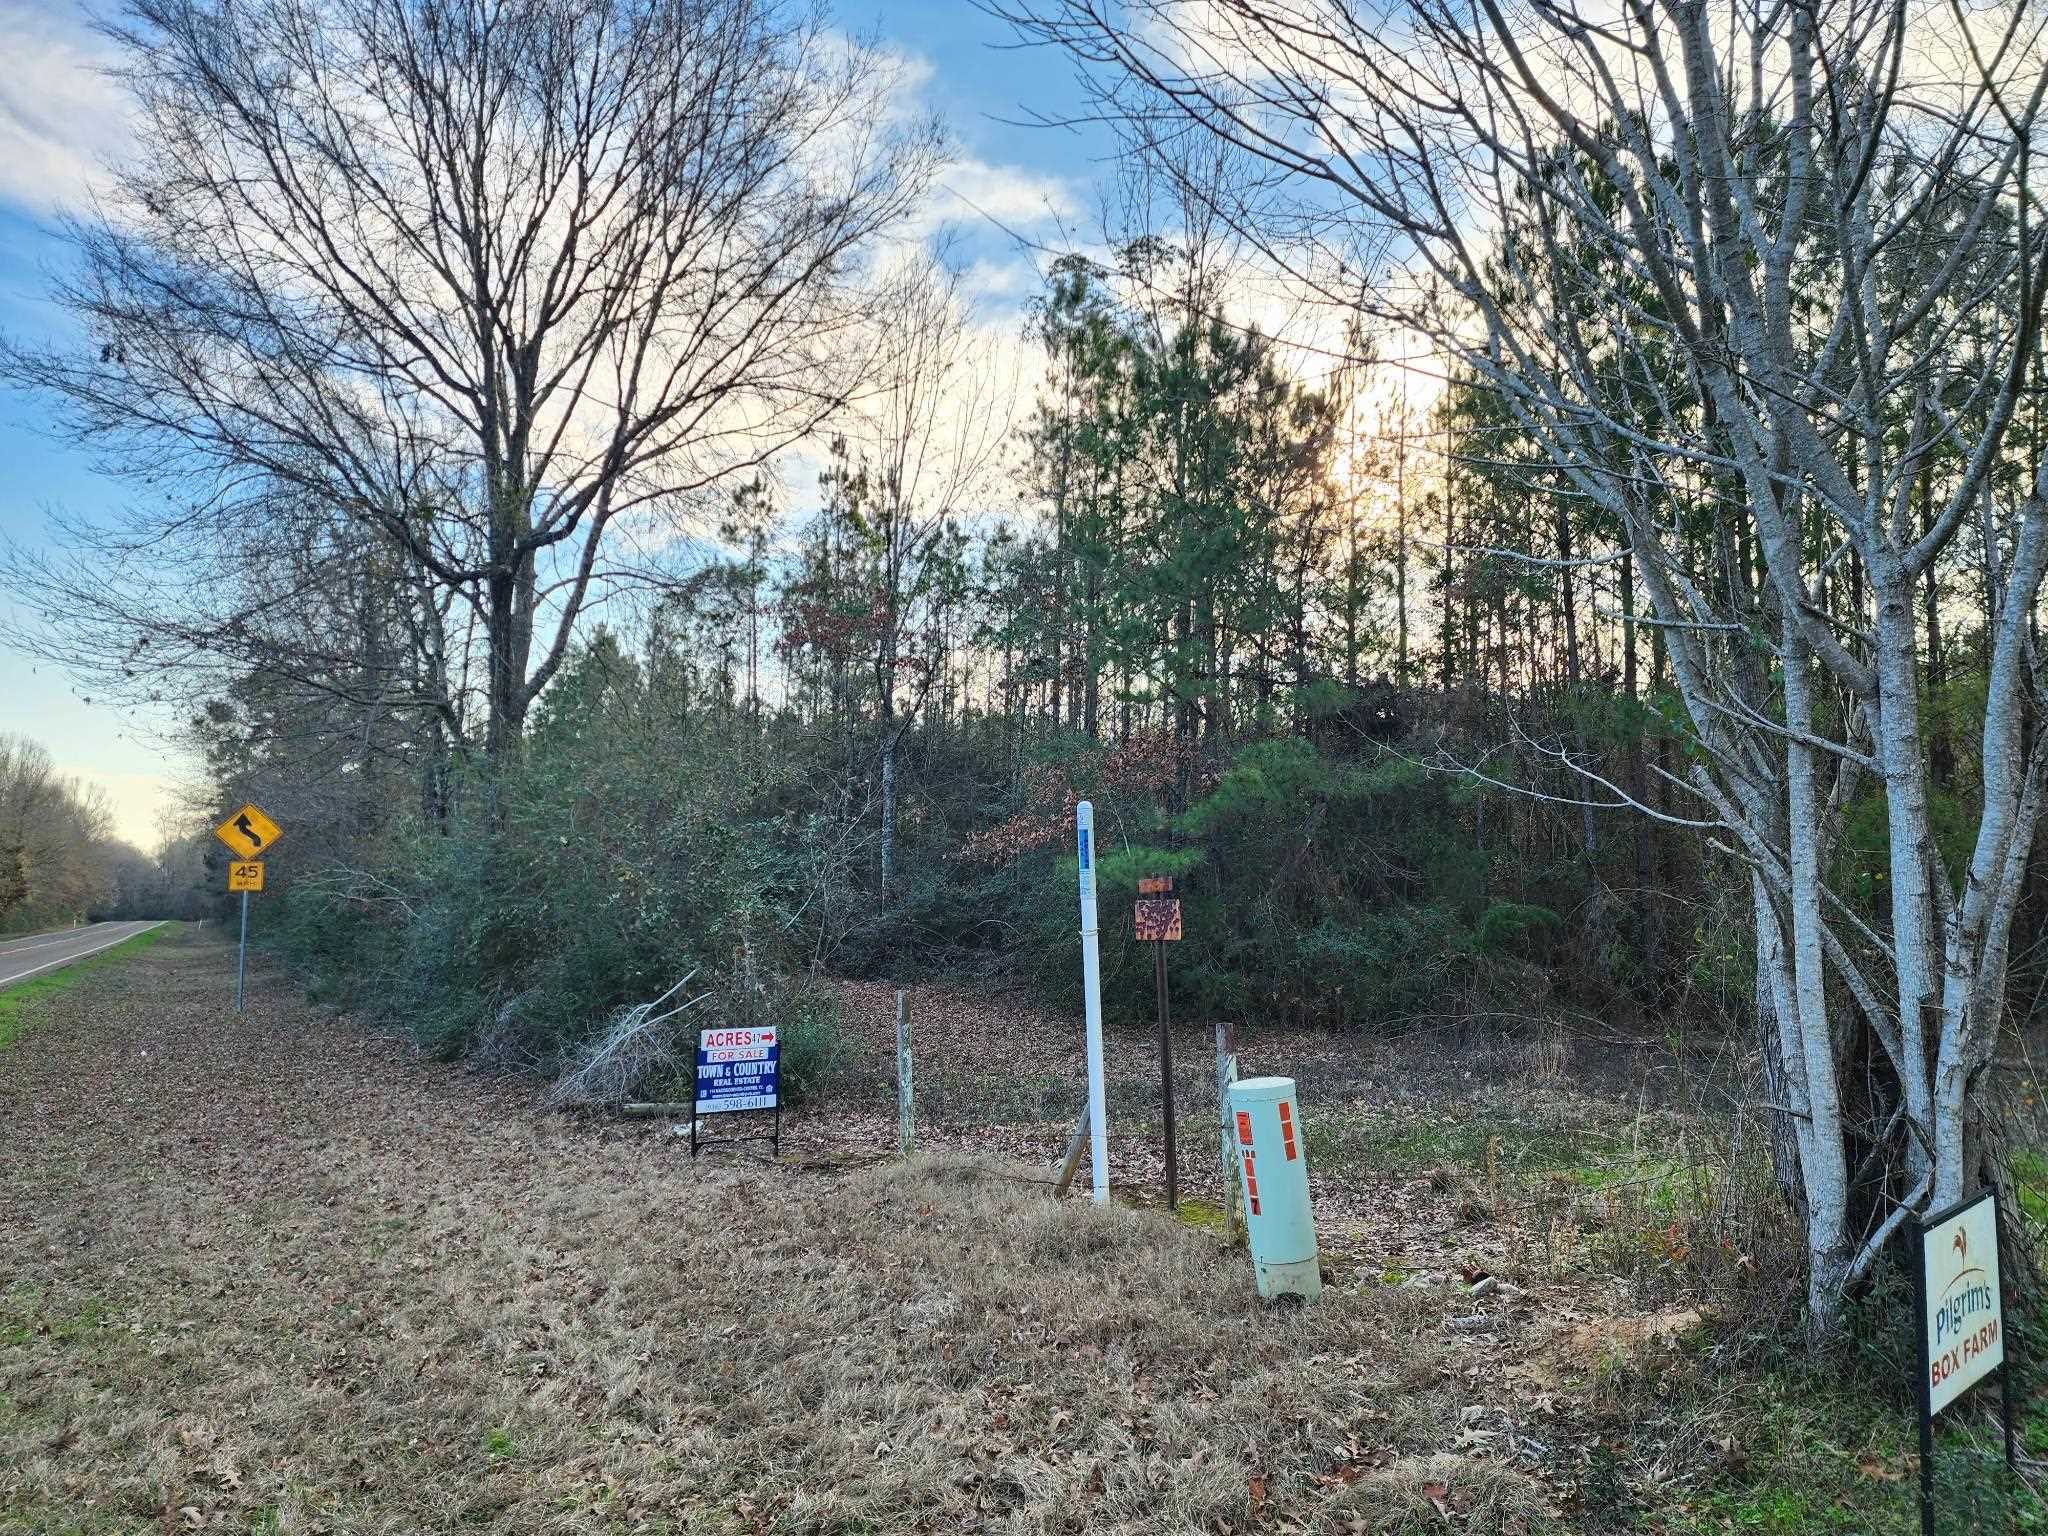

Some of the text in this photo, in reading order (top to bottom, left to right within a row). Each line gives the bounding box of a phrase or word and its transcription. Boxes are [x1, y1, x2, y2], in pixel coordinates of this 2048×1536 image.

[235, 865, 258, 879] 45
[706, 1031, 752, 1048] ACRES
[712, 1049, 764, 1061] FOR SALE
[697, 1060, 777, 1079] TOWN & COUNTRY
[713, 1076, 761, 1087] REAL ESTATE
[1931, 1319, 1999, 1389] BOX FARM
